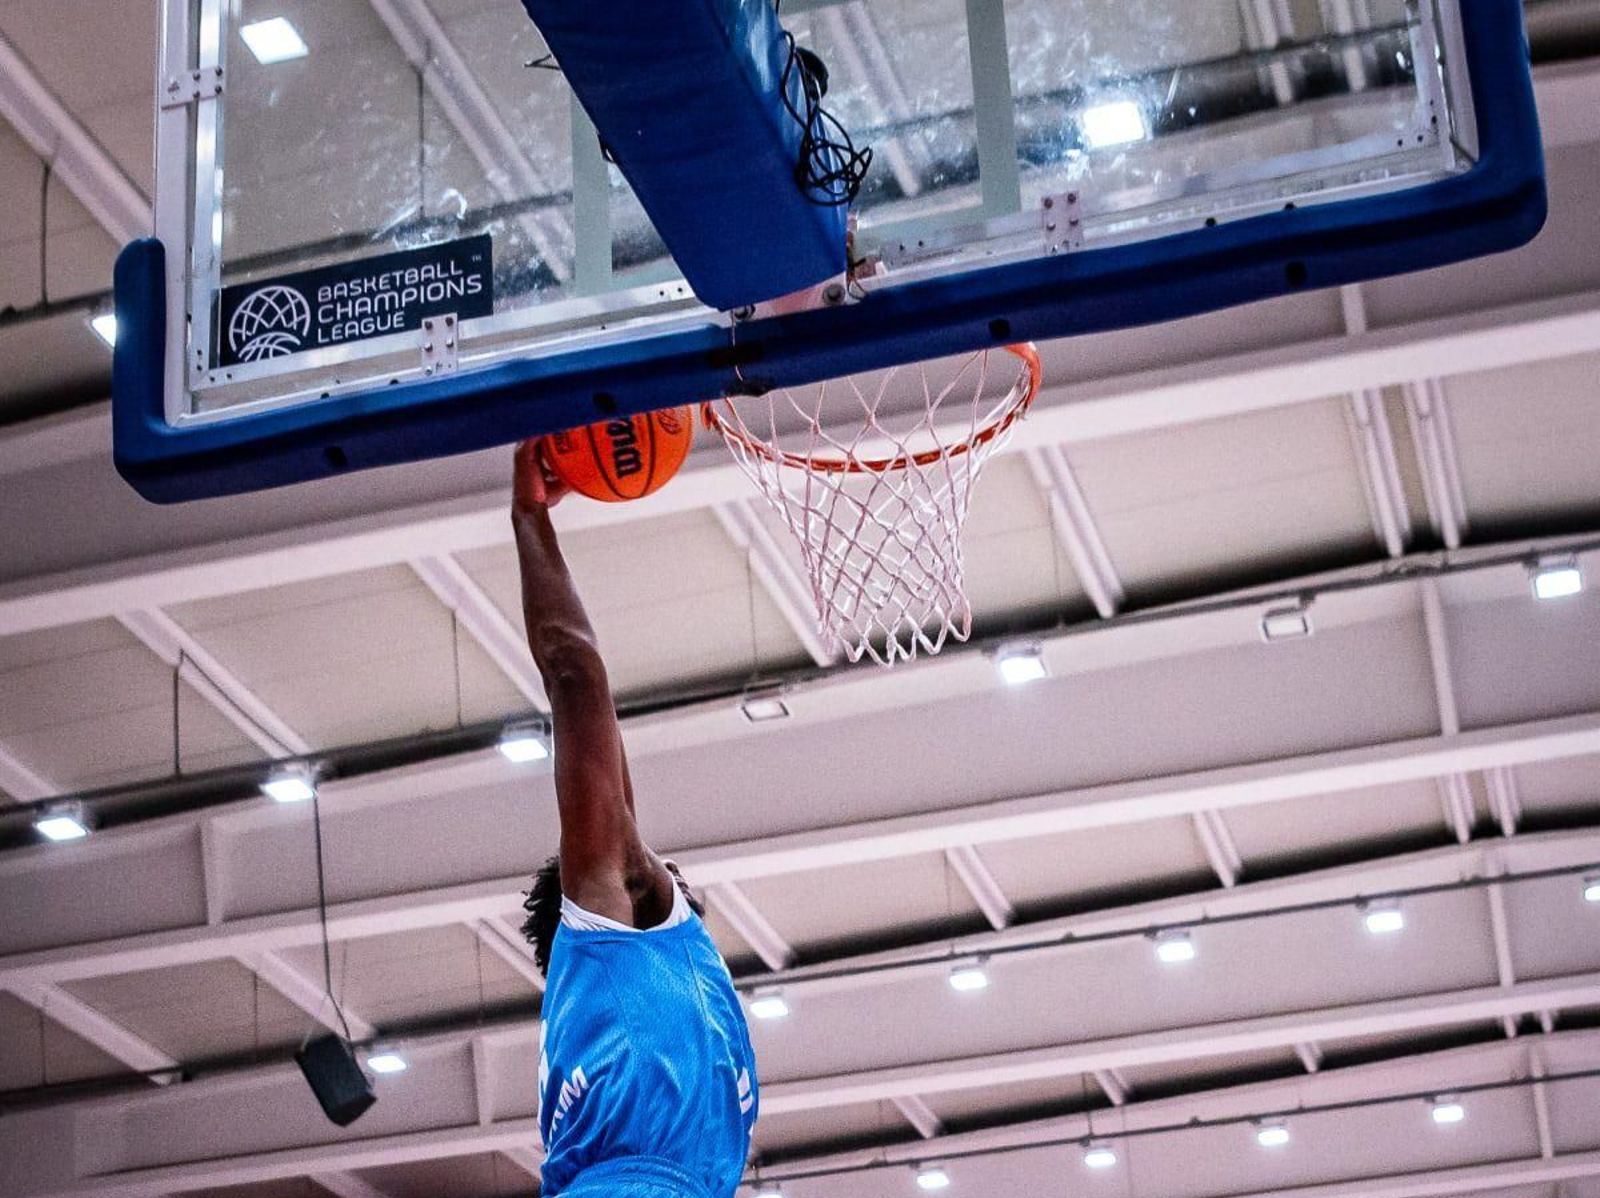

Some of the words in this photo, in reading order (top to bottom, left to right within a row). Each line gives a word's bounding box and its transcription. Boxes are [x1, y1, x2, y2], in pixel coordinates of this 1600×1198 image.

[317, 260, 463, 303] BASKETBALL
[317, 273, 483, 324] CHAMPIONS
[317, 311, 405, 343] LEAGUE
